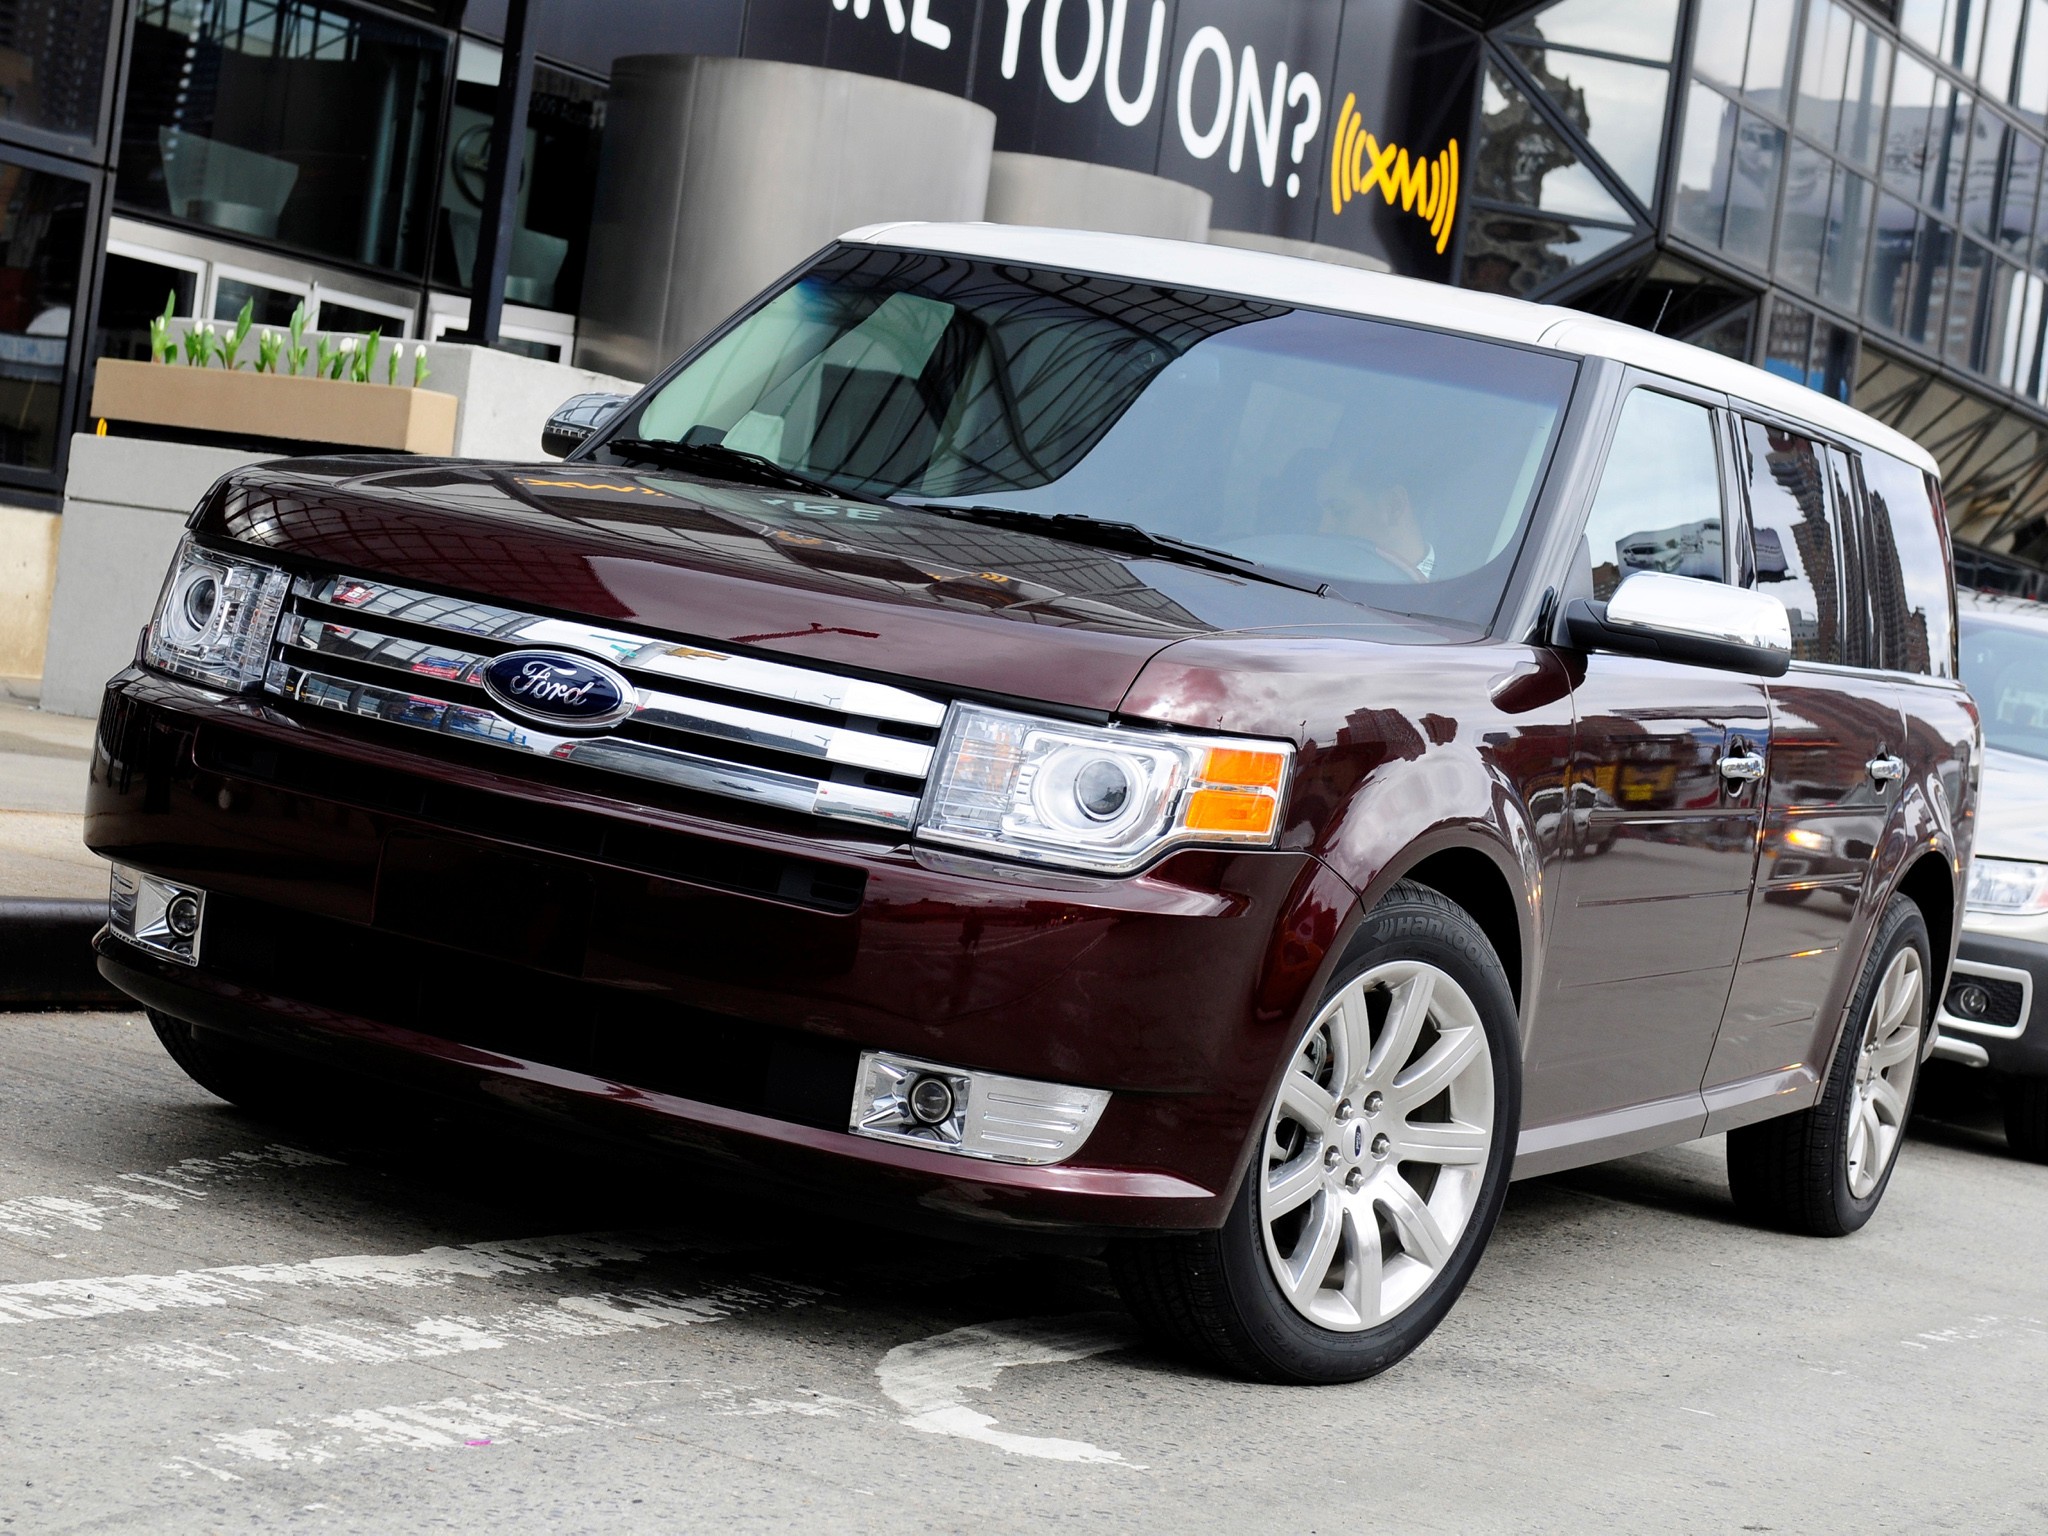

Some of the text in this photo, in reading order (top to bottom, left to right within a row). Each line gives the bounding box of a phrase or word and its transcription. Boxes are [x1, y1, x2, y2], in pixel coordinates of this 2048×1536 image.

[1000, 0, 1322, 198] YOU ON?
[510, 660, 595, 706] Ford
